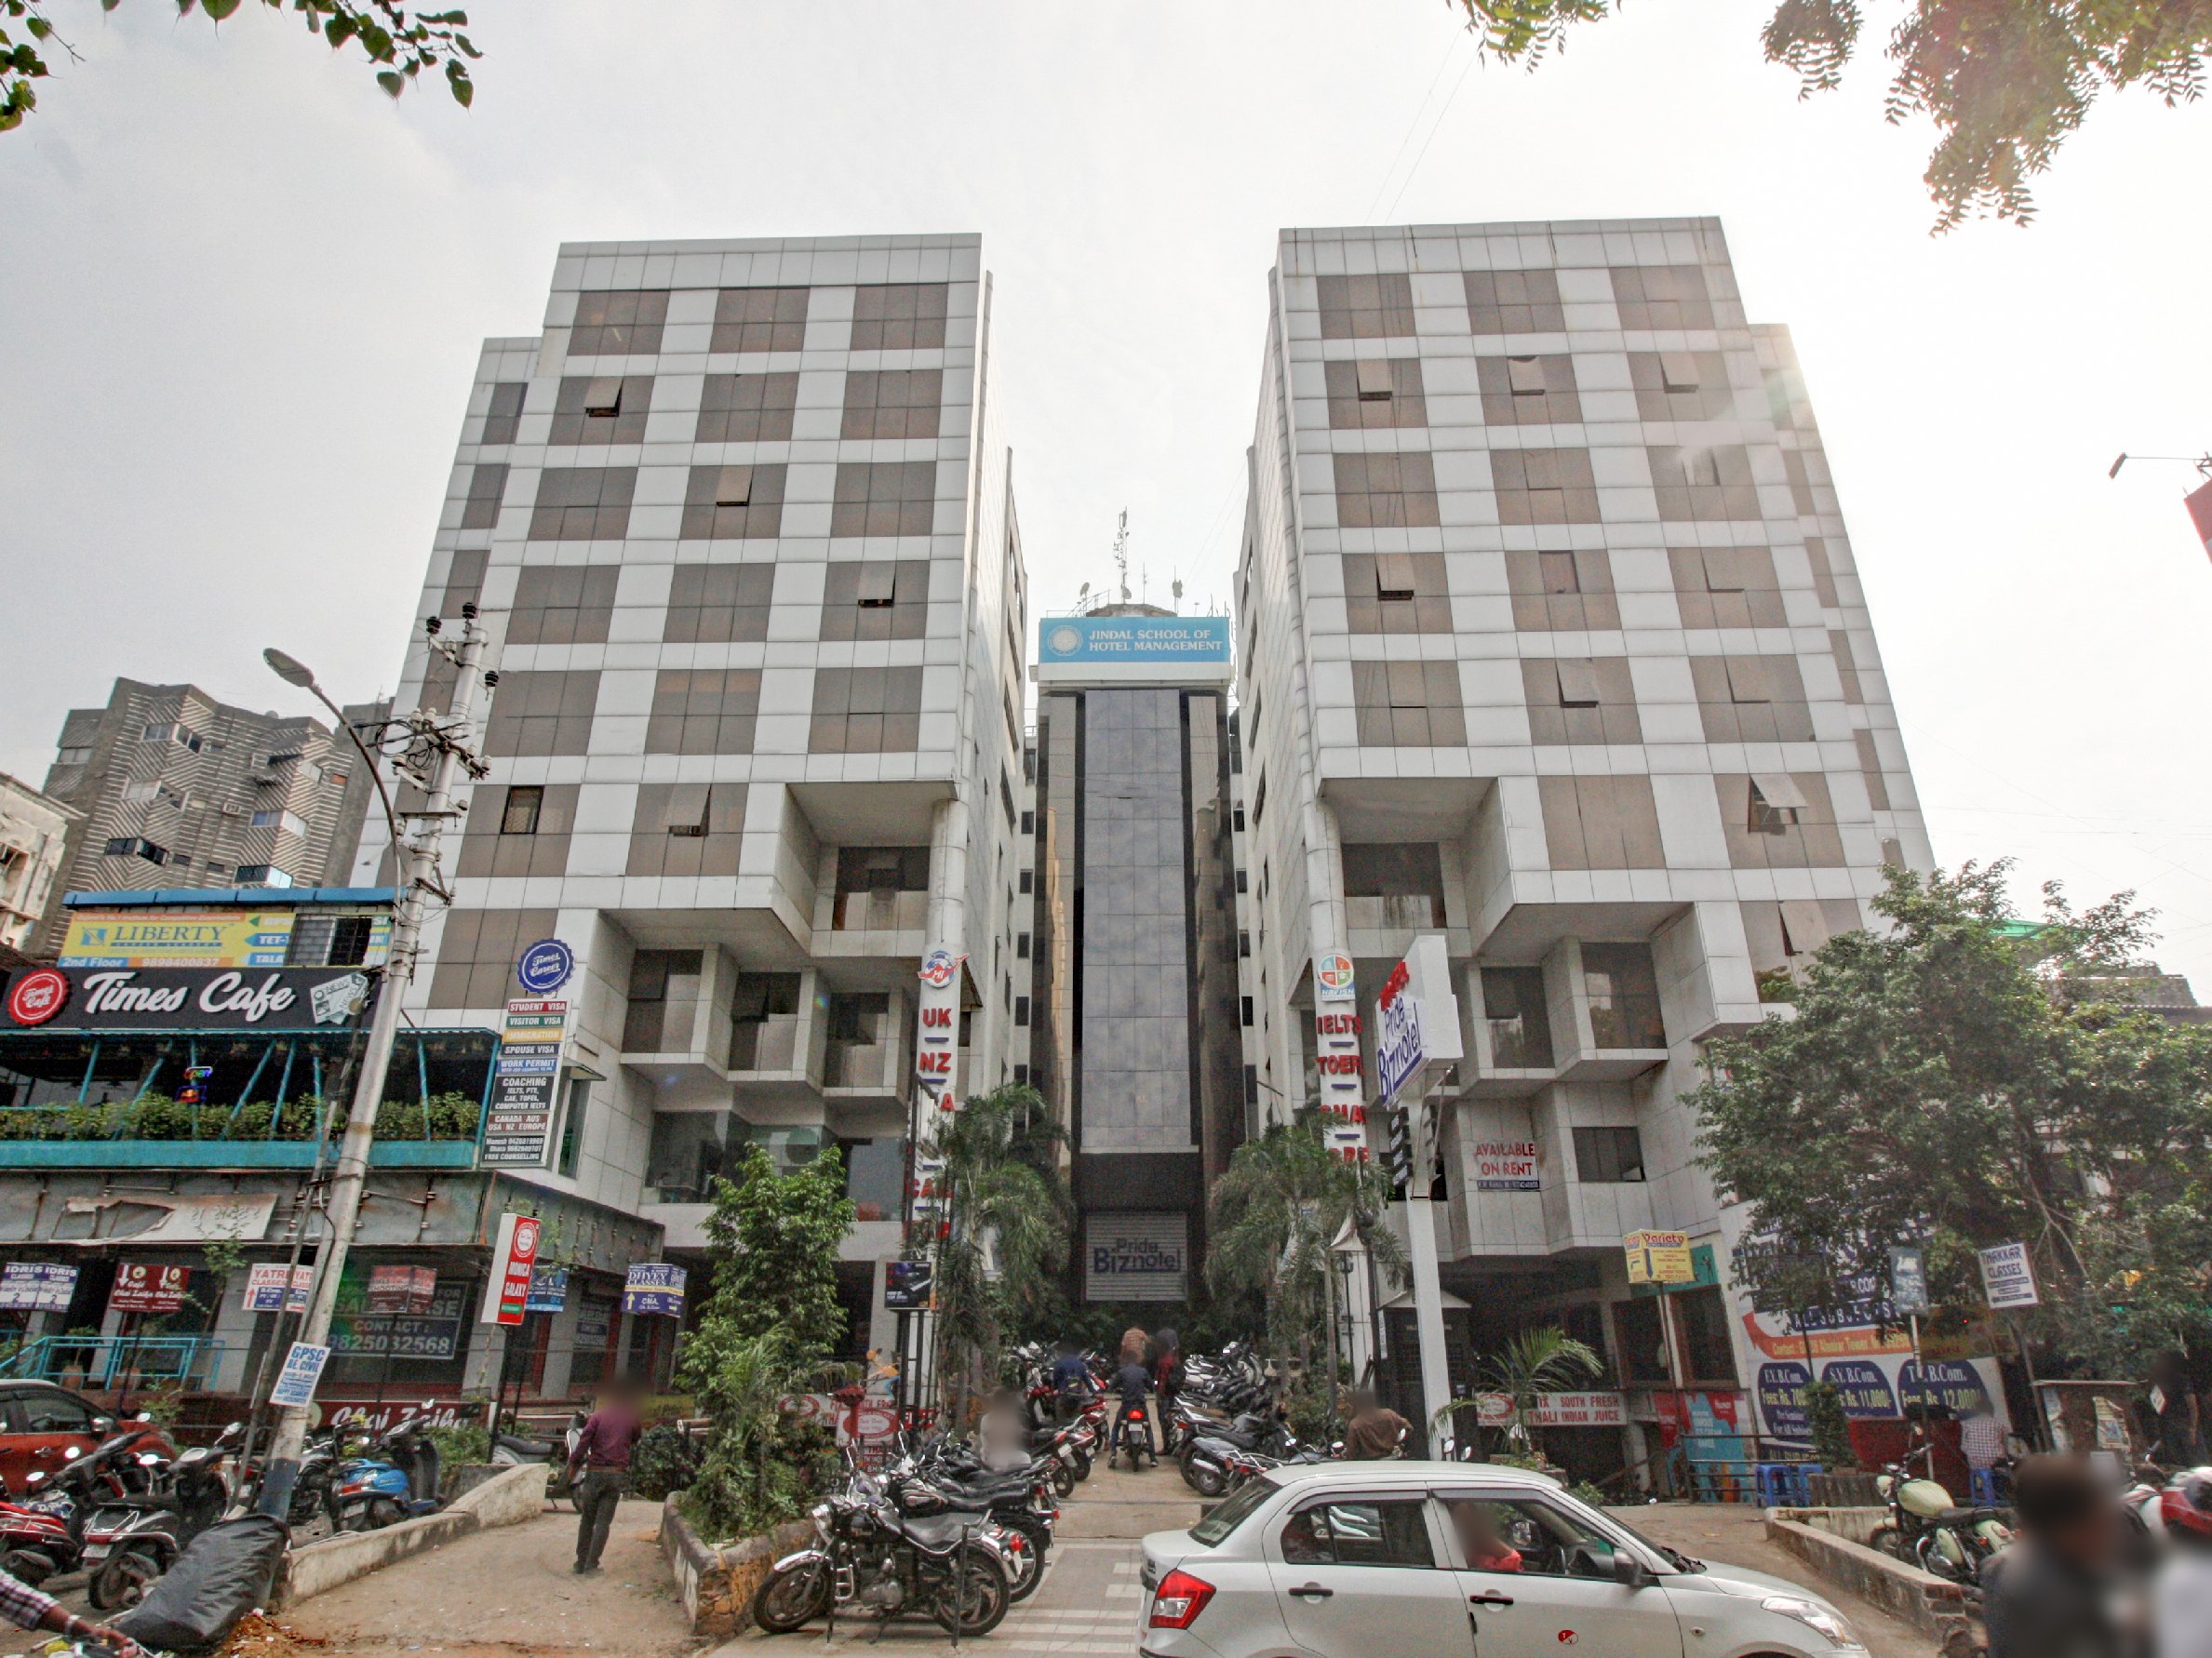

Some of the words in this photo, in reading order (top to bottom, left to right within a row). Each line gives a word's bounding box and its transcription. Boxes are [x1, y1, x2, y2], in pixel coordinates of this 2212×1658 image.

[1089, 630, 1134, 640] JINDAL
[1137, 629, 1190, 639] SCHOOL
[1194, 629, 1211, 639] OF
[1089, 641, 1130, 651] HOTEL
[1134, 640, 1223, 651] MANAGEMENT
[114, 926, 226, 941] LIBERTY
[62, 957, 87, 967] 2nd
[88, 957, 124, 967] Floor
[84, 971, 188, 1013] Times
[199, 971, 298, 1022] Cafe
[509, 1002, 543, 1012] STUDENT
[547, 1001, 566, 1011] VISA
[509, 1017, 539, 1025] VISITOR
[543, 1016, 561, 1024] VISA
[922, 1008, 952, 1027] UK
[1385, 996, 1404, 1042] Pride
[1316, 1013, 1363, 1035] IELTS
[504, 1046, 535, 1054] SPOUSE
[537, 1045, 555, 1054] VISA
[525, 1059, 556, 1067] PERMIT
[918, 1052, 952, 1072] NZ
[503, 1077, 547, 1087] COACHING
[518, 1122, 546, 1130] EUROPE
[1476, 1143, 1535, 1157] AVAILABLE
[1481, 1162, 1500, 1176] ON
[1503, 1161, 1533, 1176] RENT
[1642, 1233, 1685, 1244] Variety
[1117, 1237, 1159, 1252] Pride
[1093, 1248, 1181, 1274] Biznotel
[5, 1265, 43, 1274] IDRIS
[45, 1266, 77, 1277] IDRIS
[12, 1292, 20, 1303] 2
[291, 1345, 326, 1362] GPSC
[1561, 1396, 1586, 1408] SOUTH
[1589, 1396, 1620, 1408] FRESH
[1527, 1411, 1558, 1424] THALI
[1561, 1411, 1589, 1423] INDIAN
[1593, 1411, 1620, 1423] JUICE
